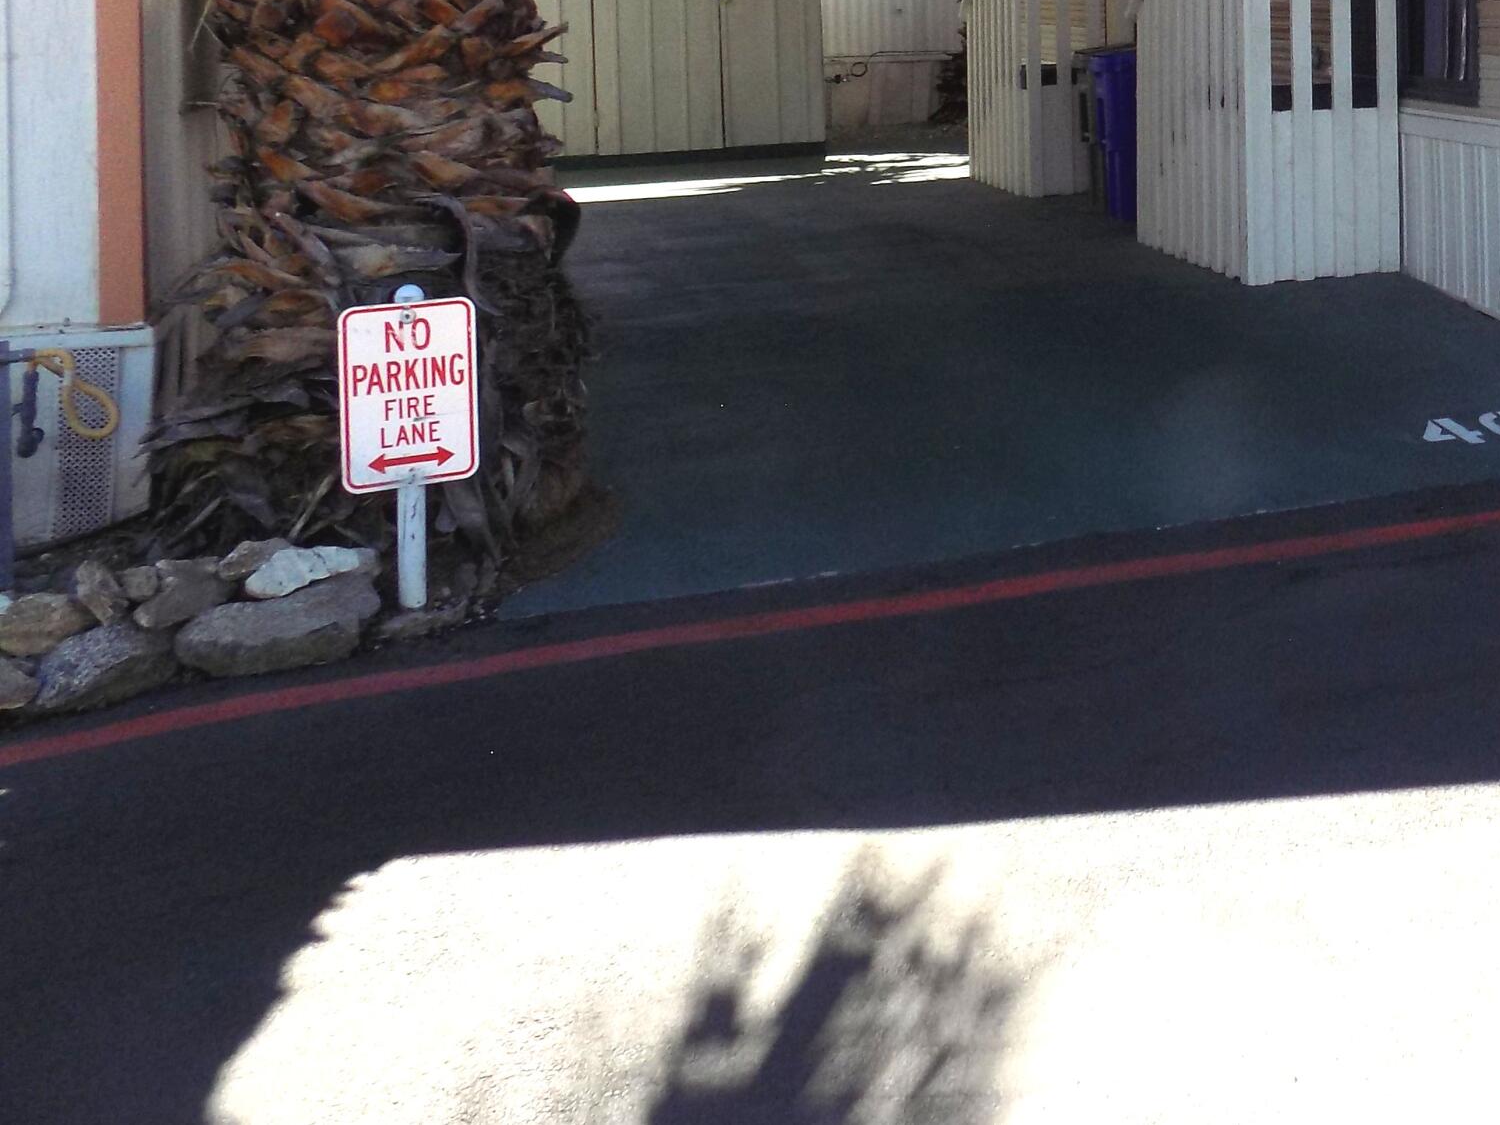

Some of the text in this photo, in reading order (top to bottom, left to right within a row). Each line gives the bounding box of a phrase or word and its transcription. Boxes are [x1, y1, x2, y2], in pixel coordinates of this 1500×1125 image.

[384, 317, 431, 353] NO
[352, 353, 465, 397] PARKING
[384, 394, 437, 422] FIRE
[380, 421, 441, 449] LANE
